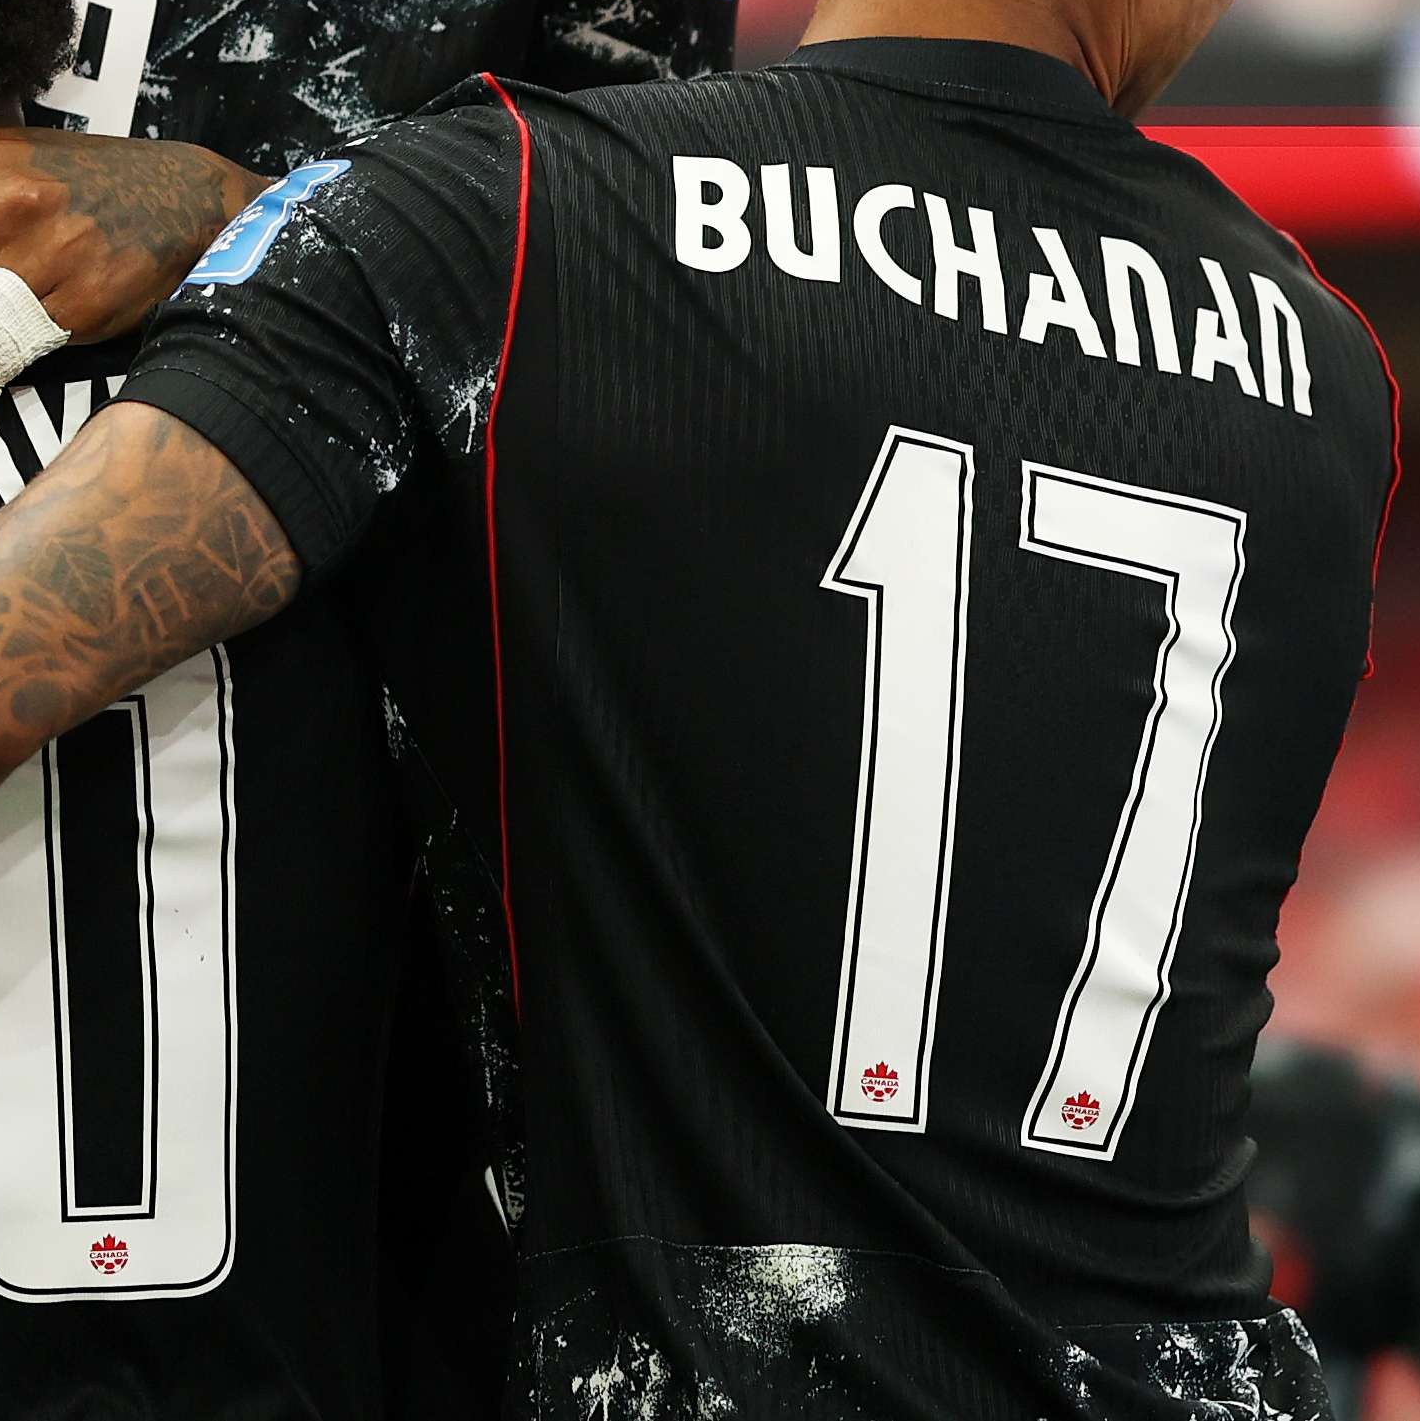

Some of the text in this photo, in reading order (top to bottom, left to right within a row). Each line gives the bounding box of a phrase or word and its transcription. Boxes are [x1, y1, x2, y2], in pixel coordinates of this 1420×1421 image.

[672, 155, 1313, 418] BUCHANAN
[819, 425, 1247, 1161] 17
[860, 1077, 899, 1087] CANADA
[1061, 1105, 1100, 1117] CANADA
[89, 1251, 129, 1259] CANADA
